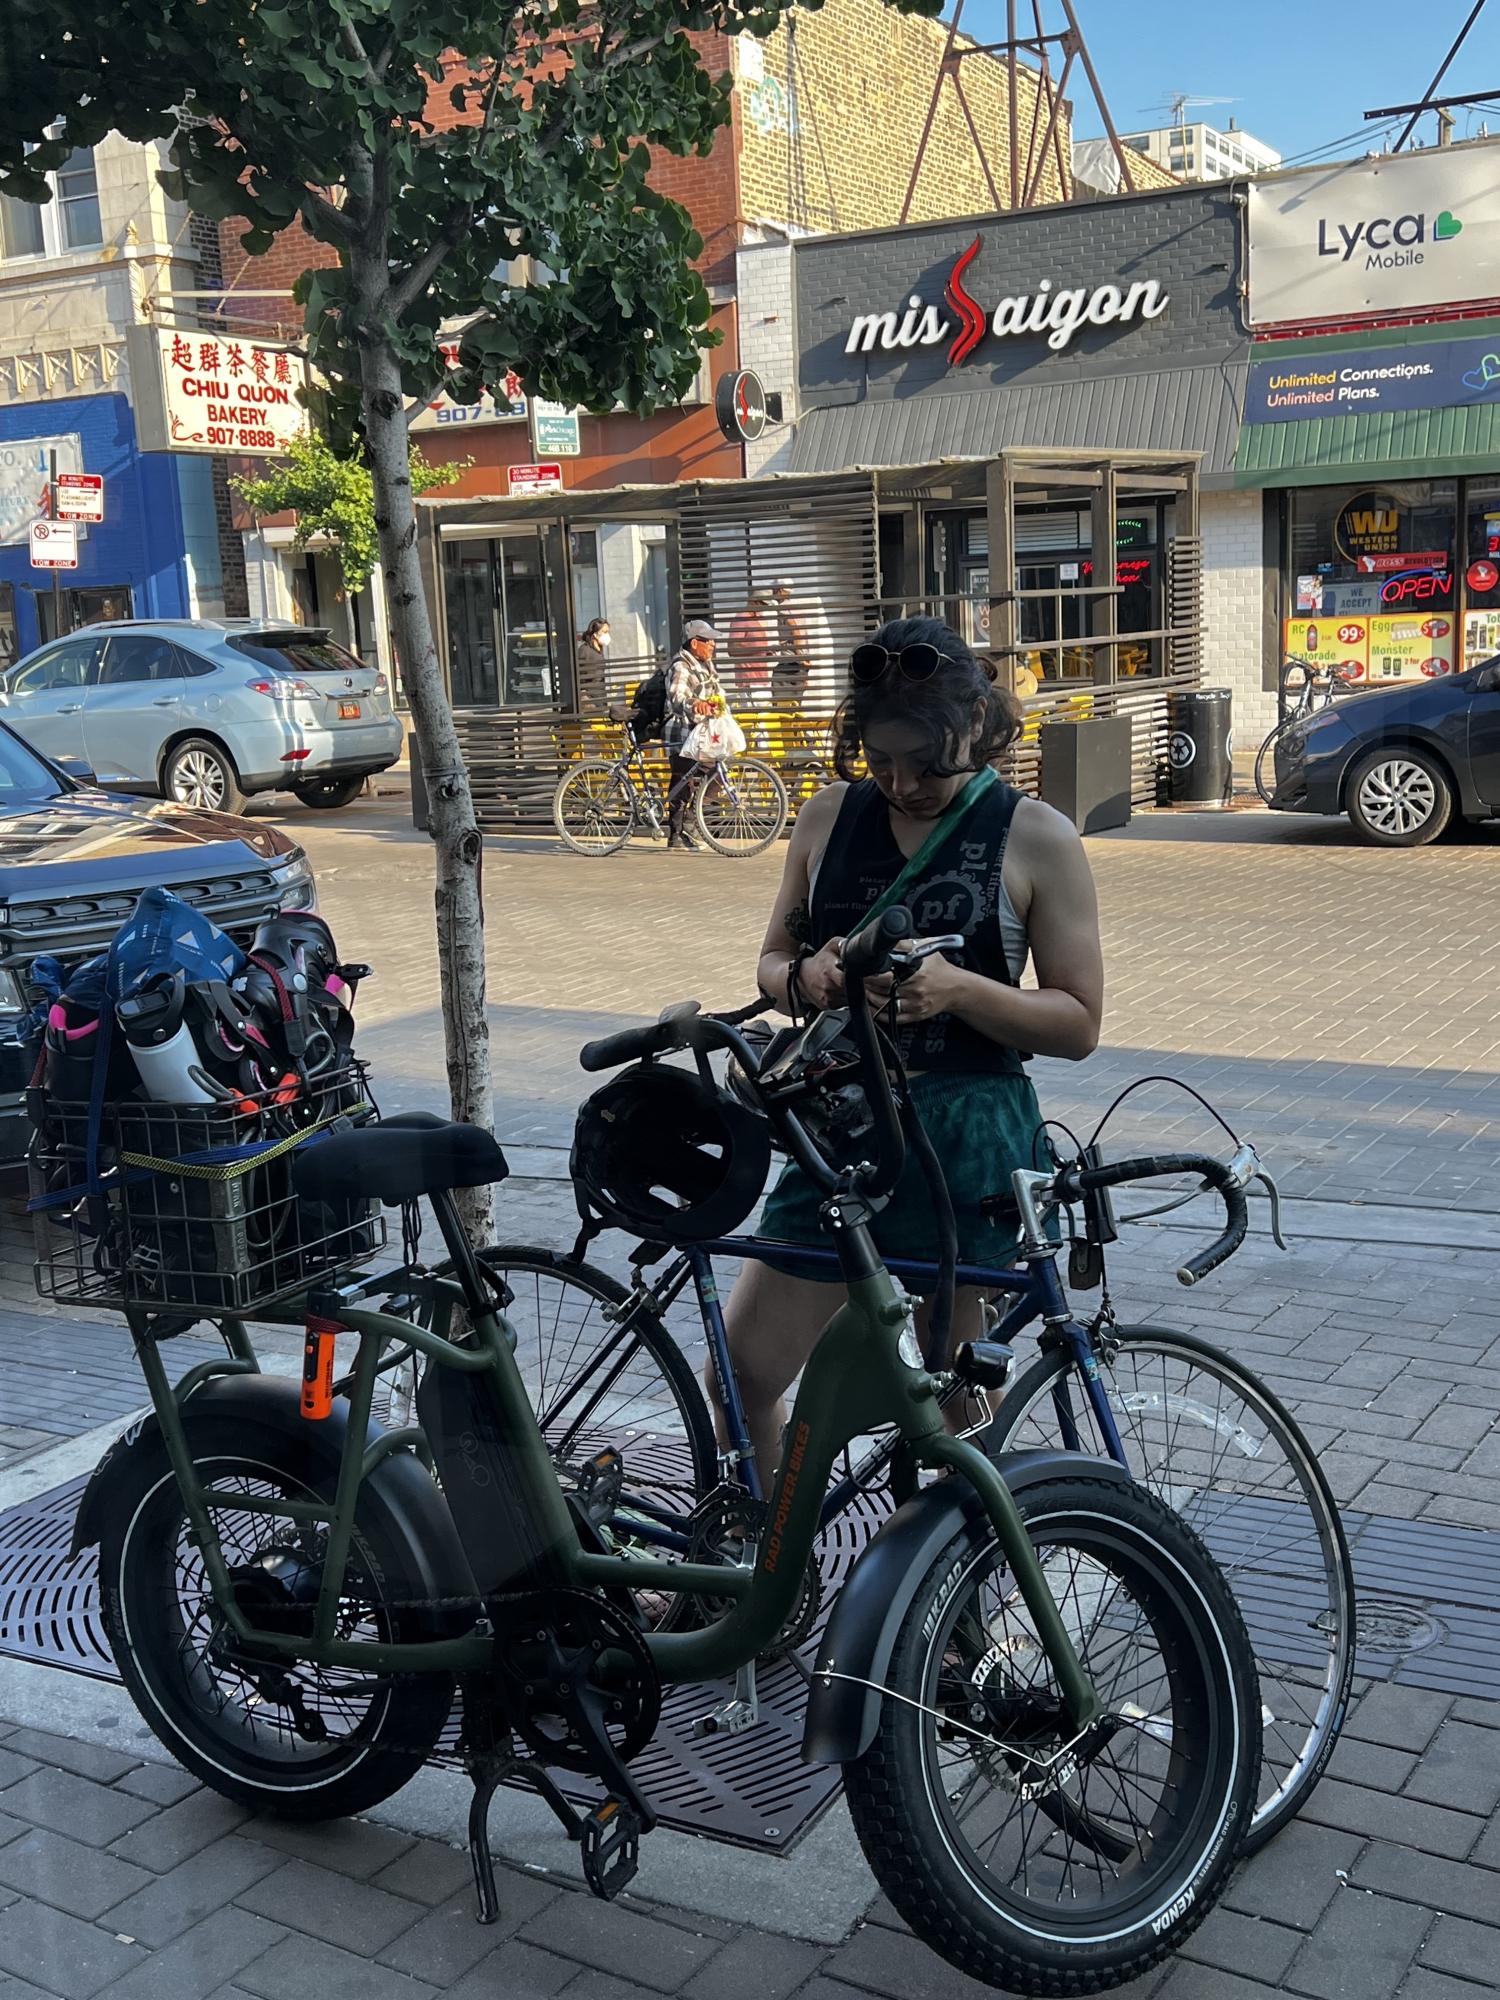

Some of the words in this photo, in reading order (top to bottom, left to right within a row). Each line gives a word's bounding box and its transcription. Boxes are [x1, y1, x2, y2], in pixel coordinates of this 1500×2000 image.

[1318, 213, 1425, 262] Lyca
[1365, 249, 1425, 271] Mobile
[171, 333, 292, 384] 超群茶餐廳
[1269, 370, 1336, 389] Unlimited
[1340, 362, 1434, 383] Connections.
[182, 378, 229, 400] CHIU
[238, 383, 289, 405] QUON
[1267, 389, 1334, 407] Unlimited
[1338, 387, 1380, 401] Plans.
[207, 404, 267, 426] BAKERY
[512, 473, 539, 481] STANDING
[1350, 535, 1398, 545] WESTERN
[1364, 543, 1398, 551] UNION
[1351, 588, 1364, 597] WE
[1382, 574, 1453, 601] OPEN
[1341, 598, 1372, 609] ACCEPT
[1292, 625, 1305, 634] RC
[1371, 645, 1413, 655] Monster
[918, 893, 967, 929] pf
[764, 1534, 780, 1573] RAD
[775, 1472, 797, 1536] POWER
[789, 1423, 810, 1472] BIKES
[1151, 1886, 1196, 1936] KENDA
